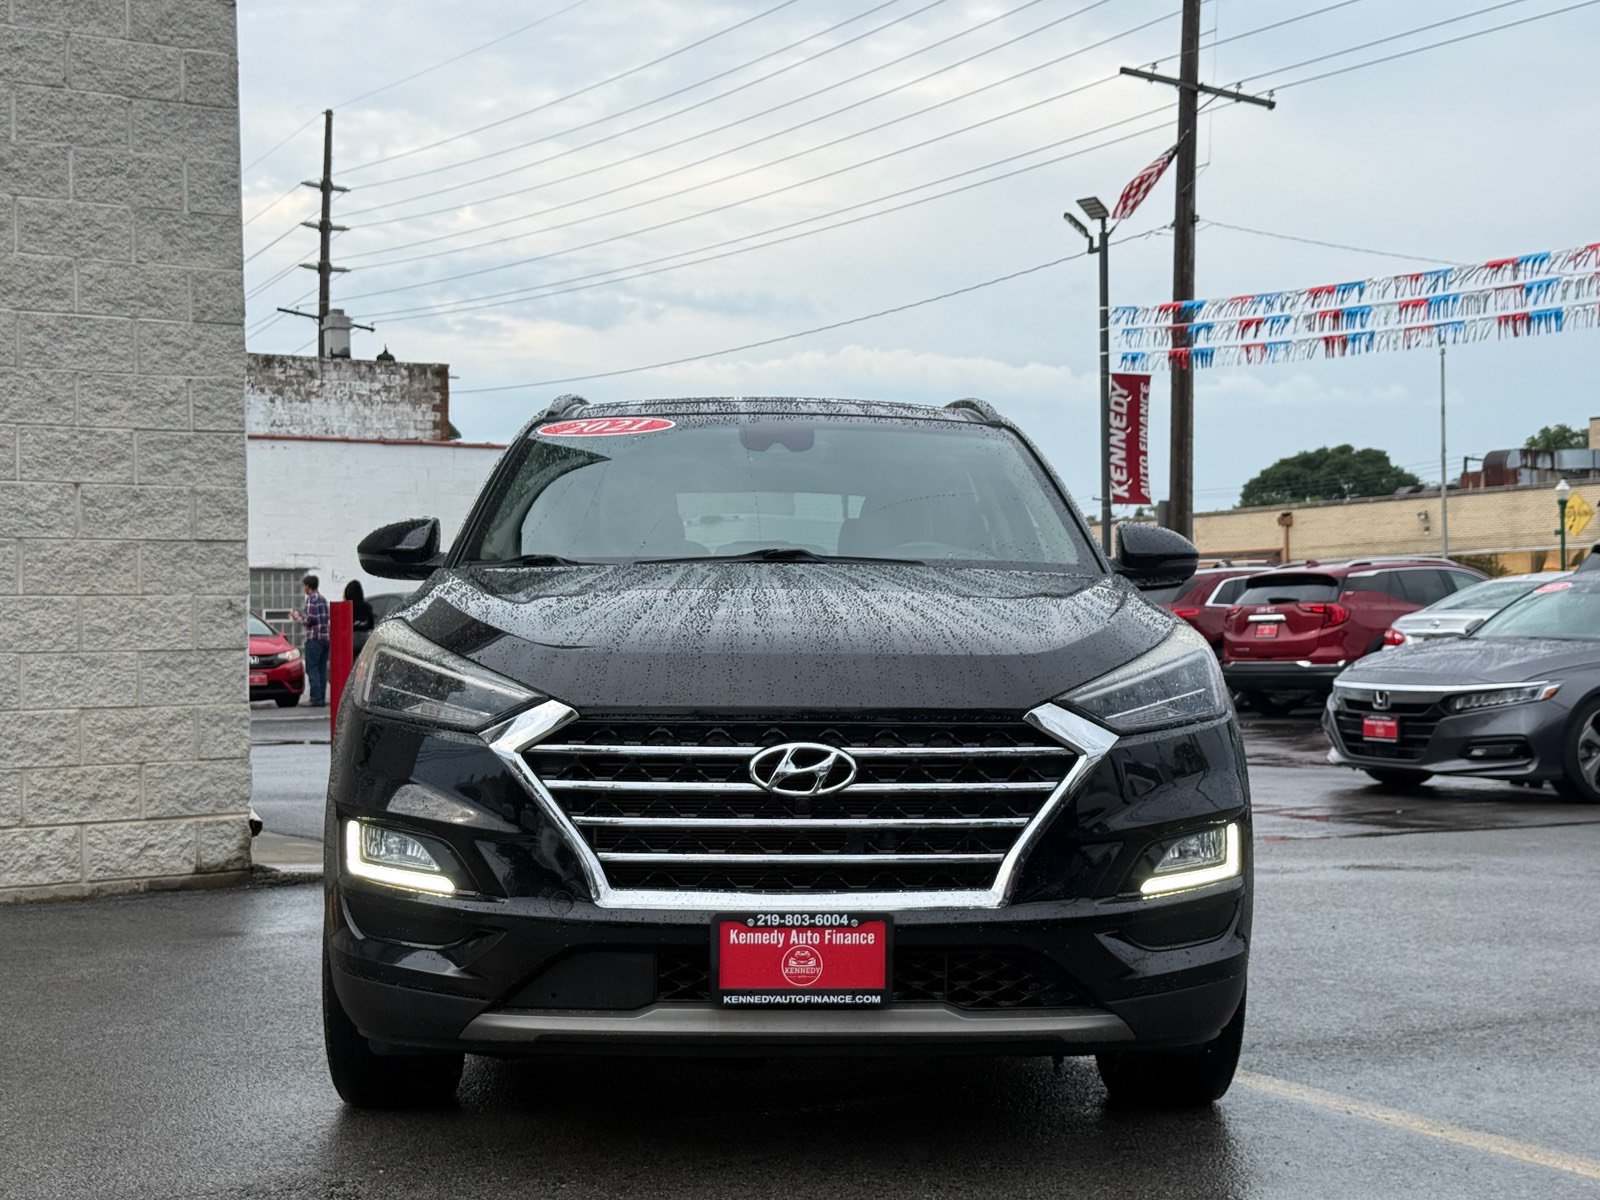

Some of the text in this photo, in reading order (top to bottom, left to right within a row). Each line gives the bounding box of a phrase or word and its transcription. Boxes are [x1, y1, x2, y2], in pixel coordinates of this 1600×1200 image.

[558, 420, 653, 434] 2021
[1109, 380, 1130, 498] KENNEDY
[1139, 455, 1150, 499] AUTO
[757, 914, 848, 926] 219-803-6004
[729, 929, 875, 947] Kennedy Auto Finance
[723, 995, 881, 1004] KENNEDYAUTOFINANCE.COM
